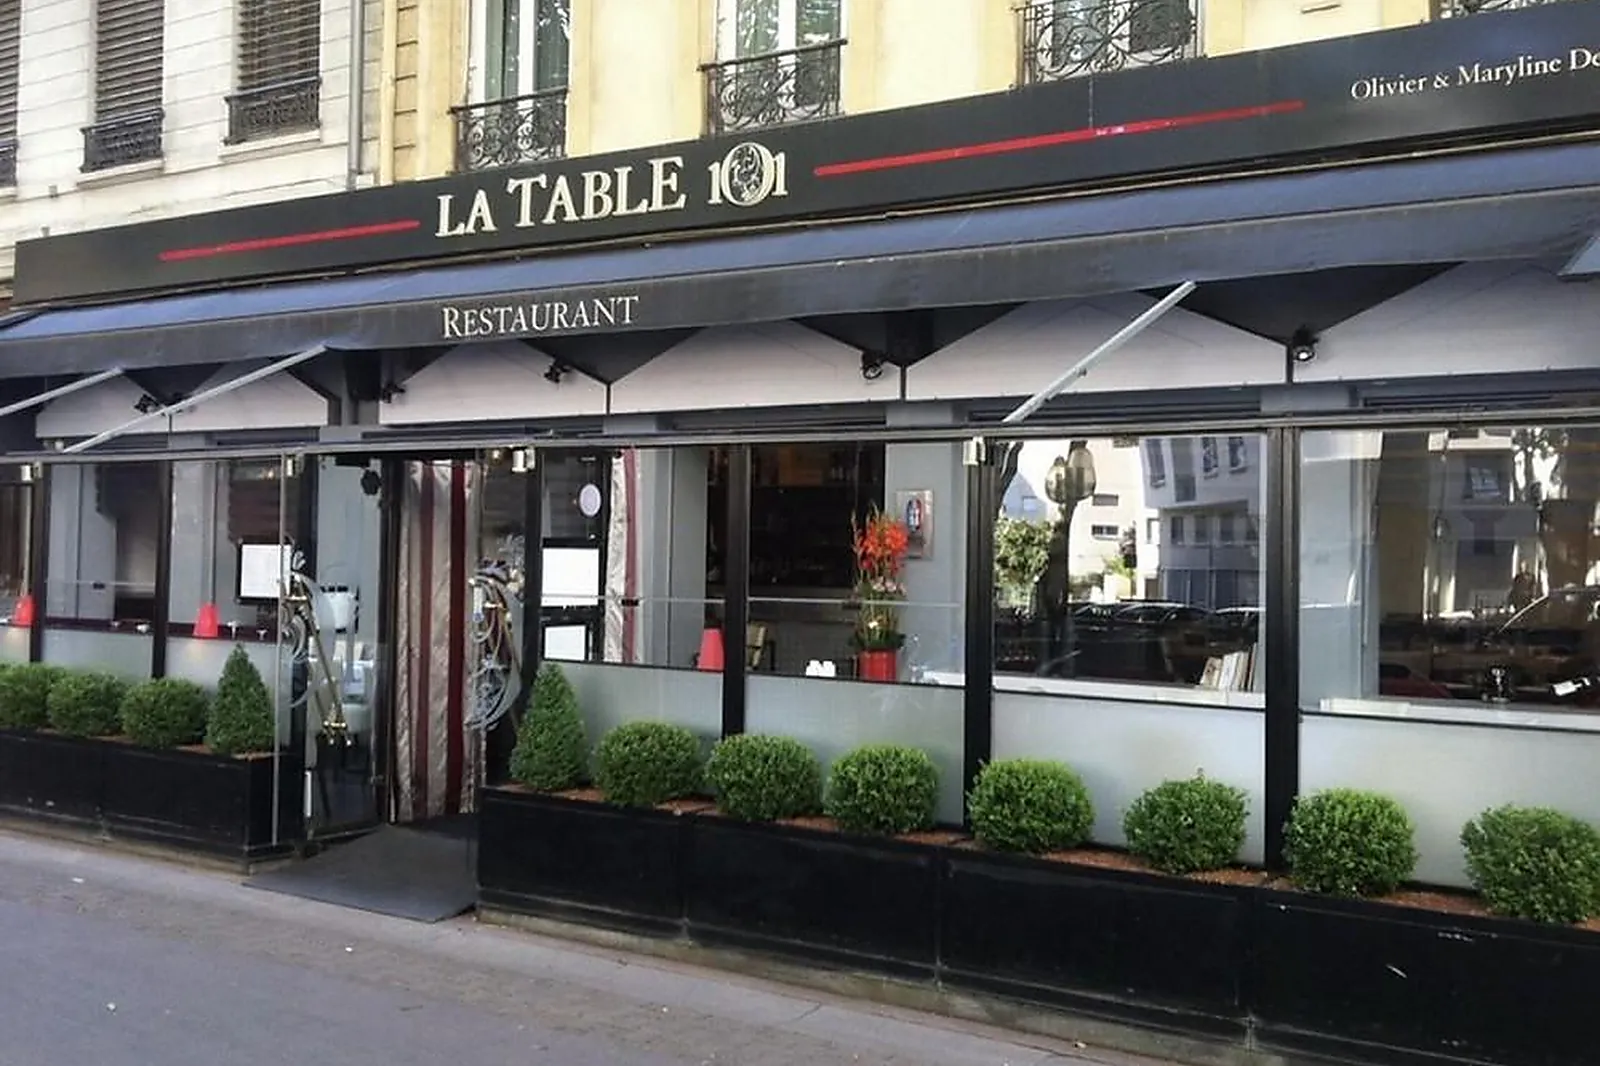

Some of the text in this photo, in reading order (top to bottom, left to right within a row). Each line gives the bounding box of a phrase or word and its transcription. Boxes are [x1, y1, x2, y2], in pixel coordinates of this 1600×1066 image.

[1351, 74, 1427, 100] Olivier
[1433, 74, 1449, 89] &
[1456, 56, 1562, 85] Maryline
[435, 142, 788, 237] LA TABLE 101
[443, 297, 638, 338] RESTAURANT
